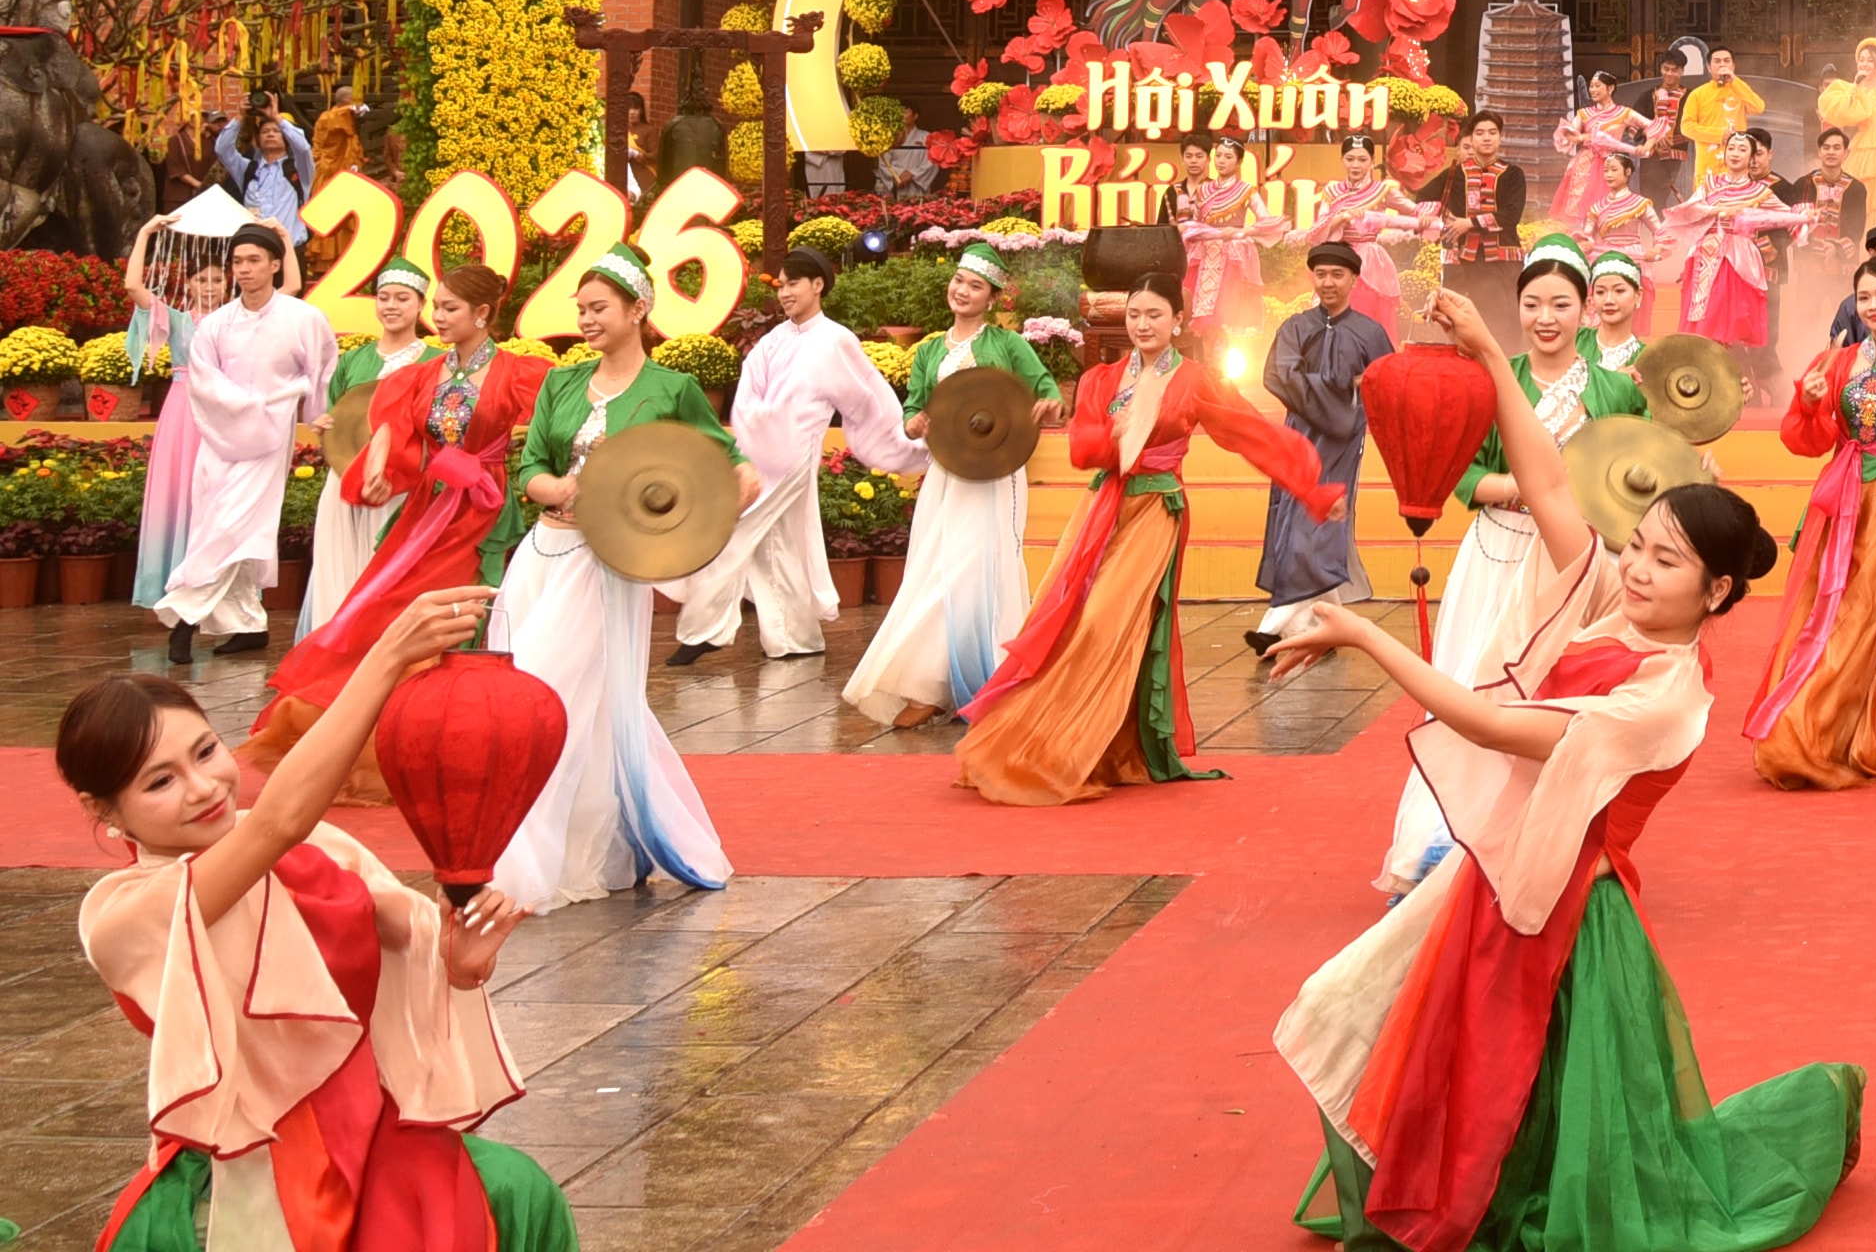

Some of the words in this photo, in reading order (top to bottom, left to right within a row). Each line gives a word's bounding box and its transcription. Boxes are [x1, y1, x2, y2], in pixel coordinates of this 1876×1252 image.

[1085, 60, 1196, 140] Hội
[1206, 60, 1390, 131] Xuân
[299, 166, 748, 340] 2026
